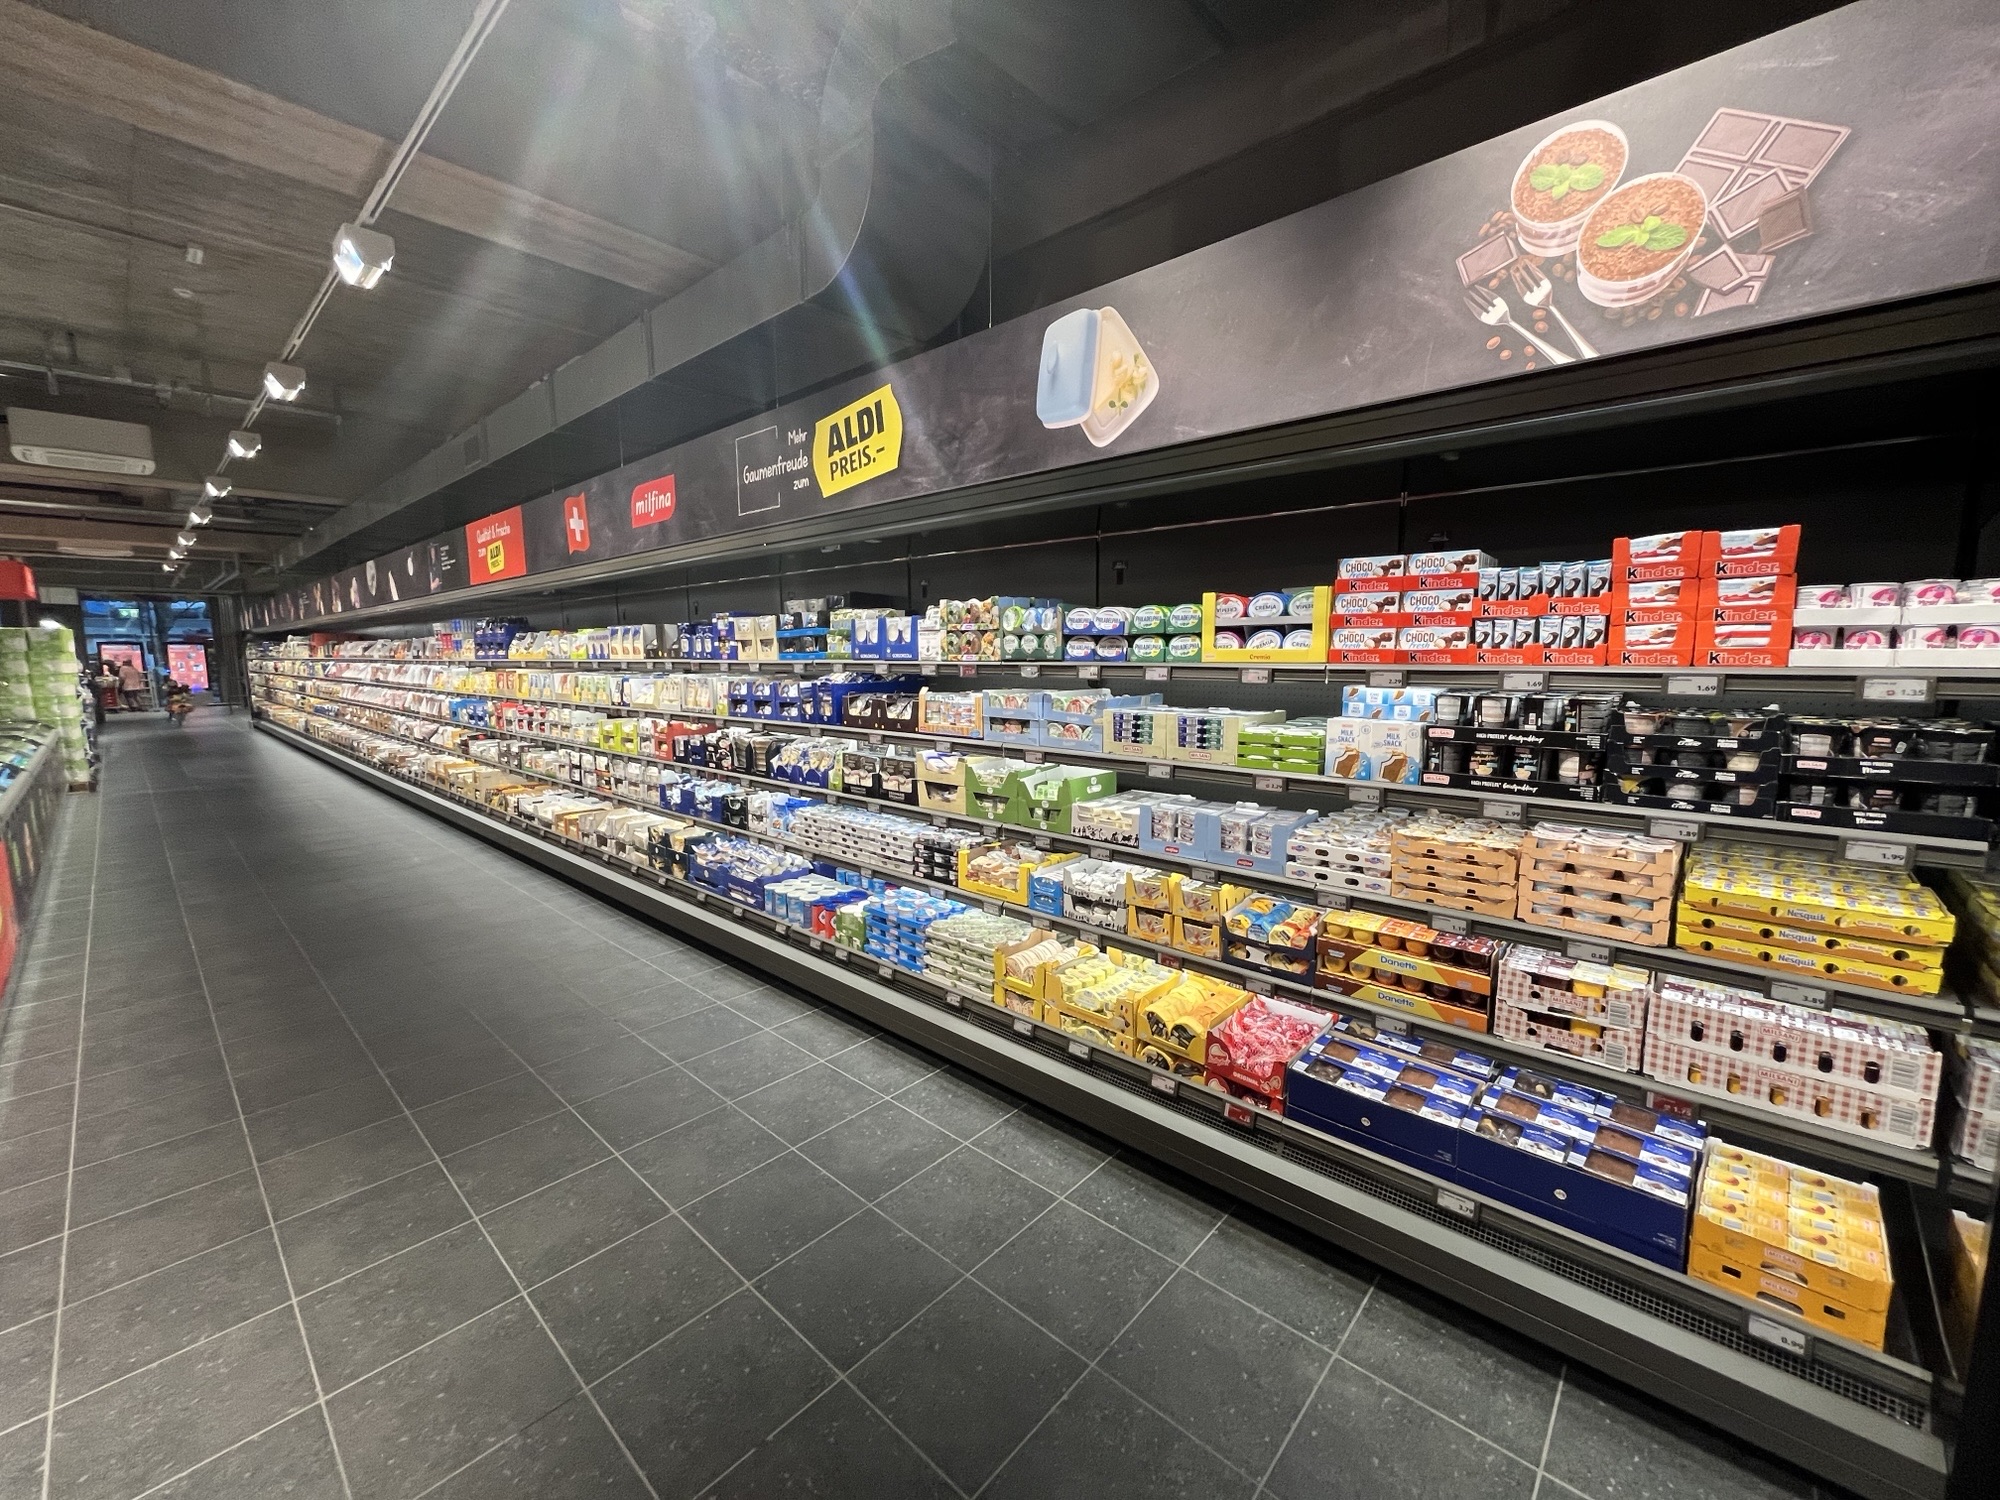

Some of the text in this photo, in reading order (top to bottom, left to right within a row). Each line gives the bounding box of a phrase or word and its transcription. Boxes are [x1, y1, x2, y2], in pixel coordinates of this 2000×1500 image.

[828, 399, 885, 458] ALDI
[788, 428, 808, 446] Mehr
[743, 449, 809, 485] Gaumenfreude
[830, 445, 886, 481] PREIS.-
[793, 477, 810, 490] zum
[635, 491, 672, 517] milfina
[491, 524, 497, 539] &
[495, 520, 511, 537] Frische
[490, 544, 502, 561] ALDI
[1345, 562, 1373, 573] CHOCO
[1415, 557, 1446, 569] CHOCO
[1341, 597, 1368, 608] CHOCO
[1410, 595, 1440, 606] CHOCO
[1338, 633, 1365, 643] CHOCO
[1405, 632, 1435, 643] CHOCO
[1337, 735, 1355, 743] SNACK
[1386, 732, 1401, 740] MILK
[1383, 739, 1402, 747] SNACK
[1678, 829, 1697, 838] 1.89
[1881, 852, 1904, 861] 1.99
[1786, 909, 1826, 922] Nesquik
[1452, 924, 1466, 932] 1.19
[1778, 929, 1817, 944] Nesquik
[1380, 954, 1418, 971] Danette
[1777, 953, 1817, 968] Nesquik
[1378, 991, 1415, 1008] Danette
[1552, 996, 1584, 1009] MILSANI
[1549, 1034, 1579, 1047] MILSANI
[1762, 1027, 1799, 1042] MILSANI
[1232, 1071, 1260, 1087] ORIGINAL
[1760, 1070, 1798, 1085] MILSANI
